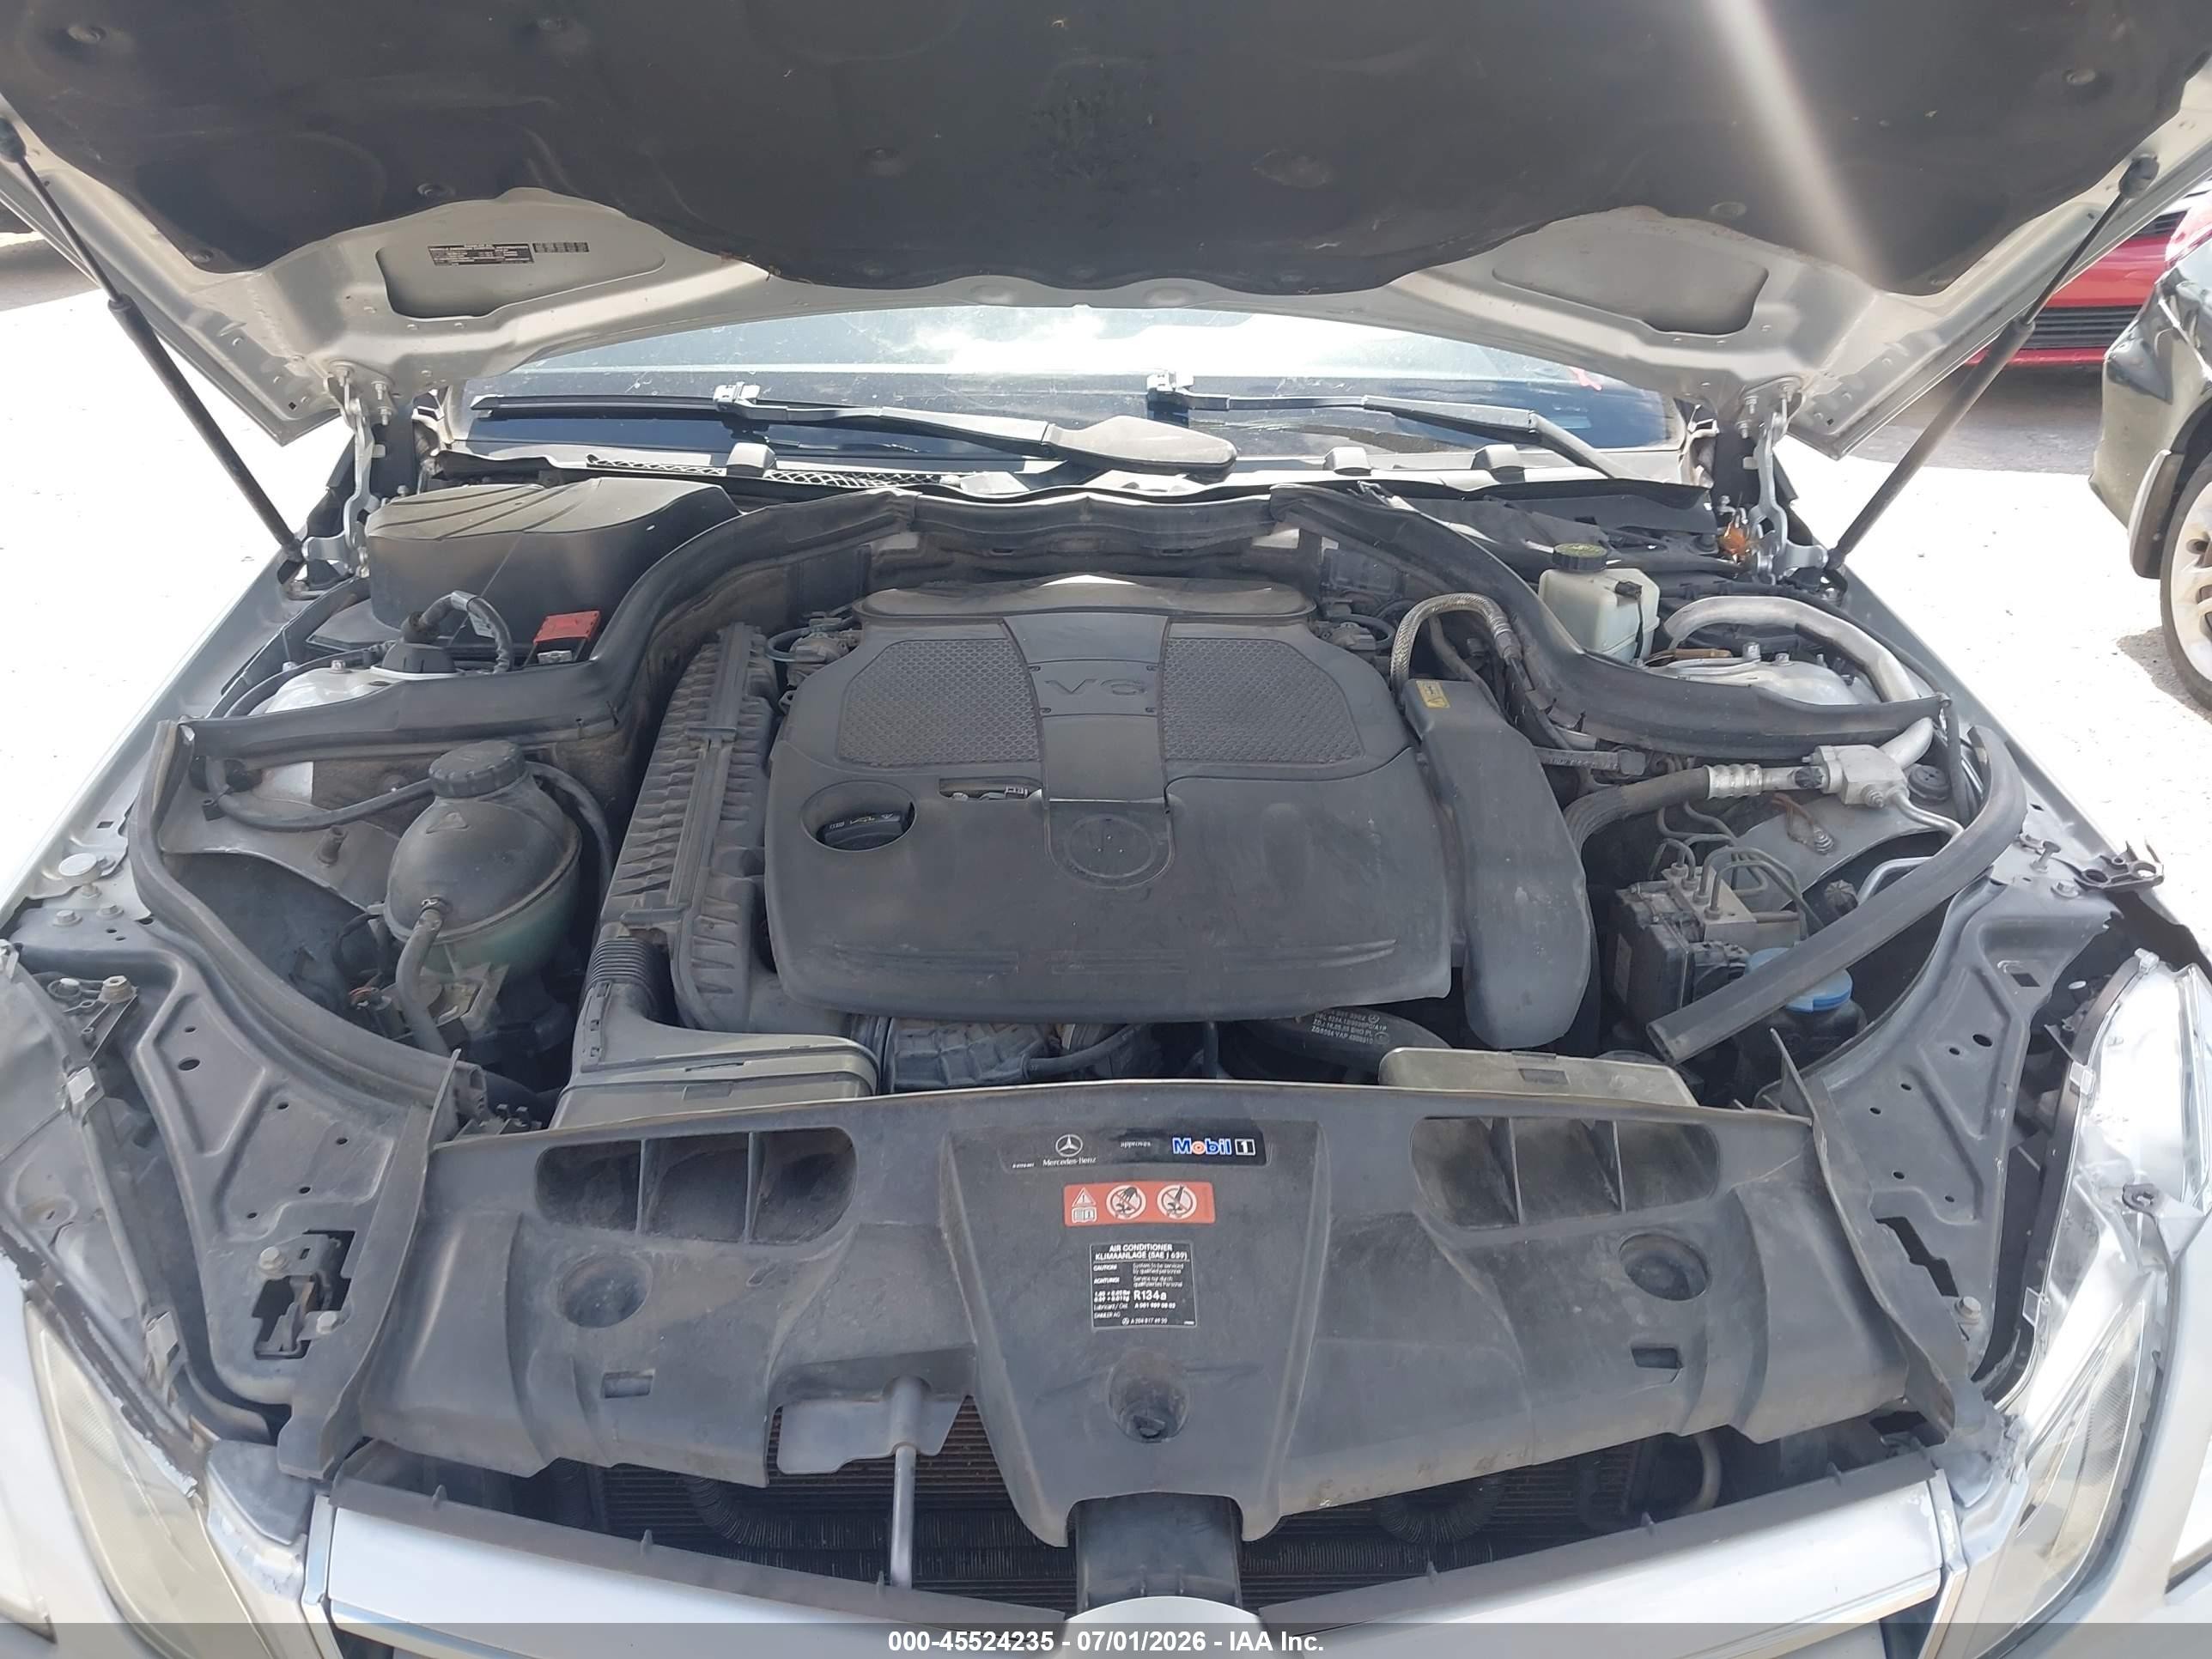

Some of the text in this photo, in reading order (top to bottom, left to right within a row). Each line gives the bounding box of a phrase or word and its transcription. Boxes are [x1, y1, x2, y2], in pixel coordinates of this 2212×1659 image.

[1120, 1139, 1152, 1149] approves
[1172, 1137, 1232, 1155] Mobil
[1042, 1157, 1097, 1168] Mercedes-Benz
[1122, 1243, 1173, 1252] CONDITIONER
[1095, 1252, 1146, 1261] KLIMAANLAGE
[1148, 1251, 1164, 1261] (SAE
[1170, 1251, 1188, 1260] 639)
[1133, 1290, 1167, 1301] R134a
